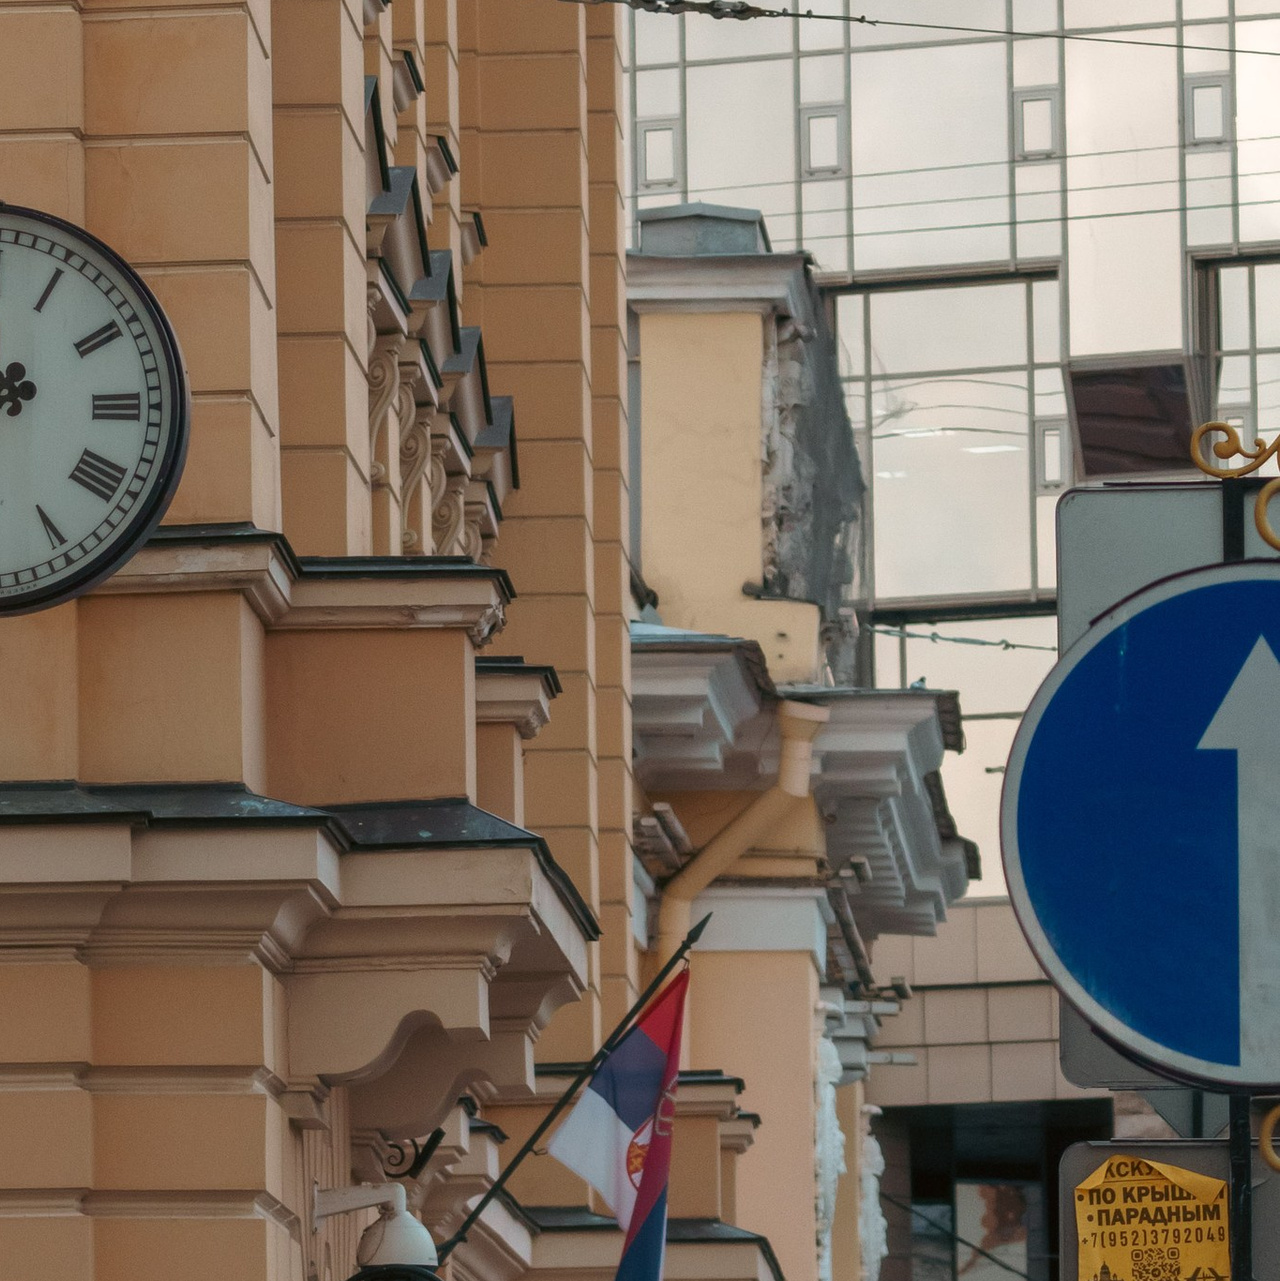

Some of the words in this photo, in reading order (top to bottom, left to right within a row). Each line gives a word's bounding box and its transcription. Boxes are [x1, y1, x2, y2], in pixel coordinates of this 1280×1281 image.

[73, 319, 124, 359] II
[92, 392, 140, 422] III
[35, 504, 68, 550] V
[1089, 1188, 1116, 1205] ПО
[1097, 1204, 1221, 1227] ПАРАДНЫМ
[1082, 1226, 1226, 1248] +7(952)3792049
